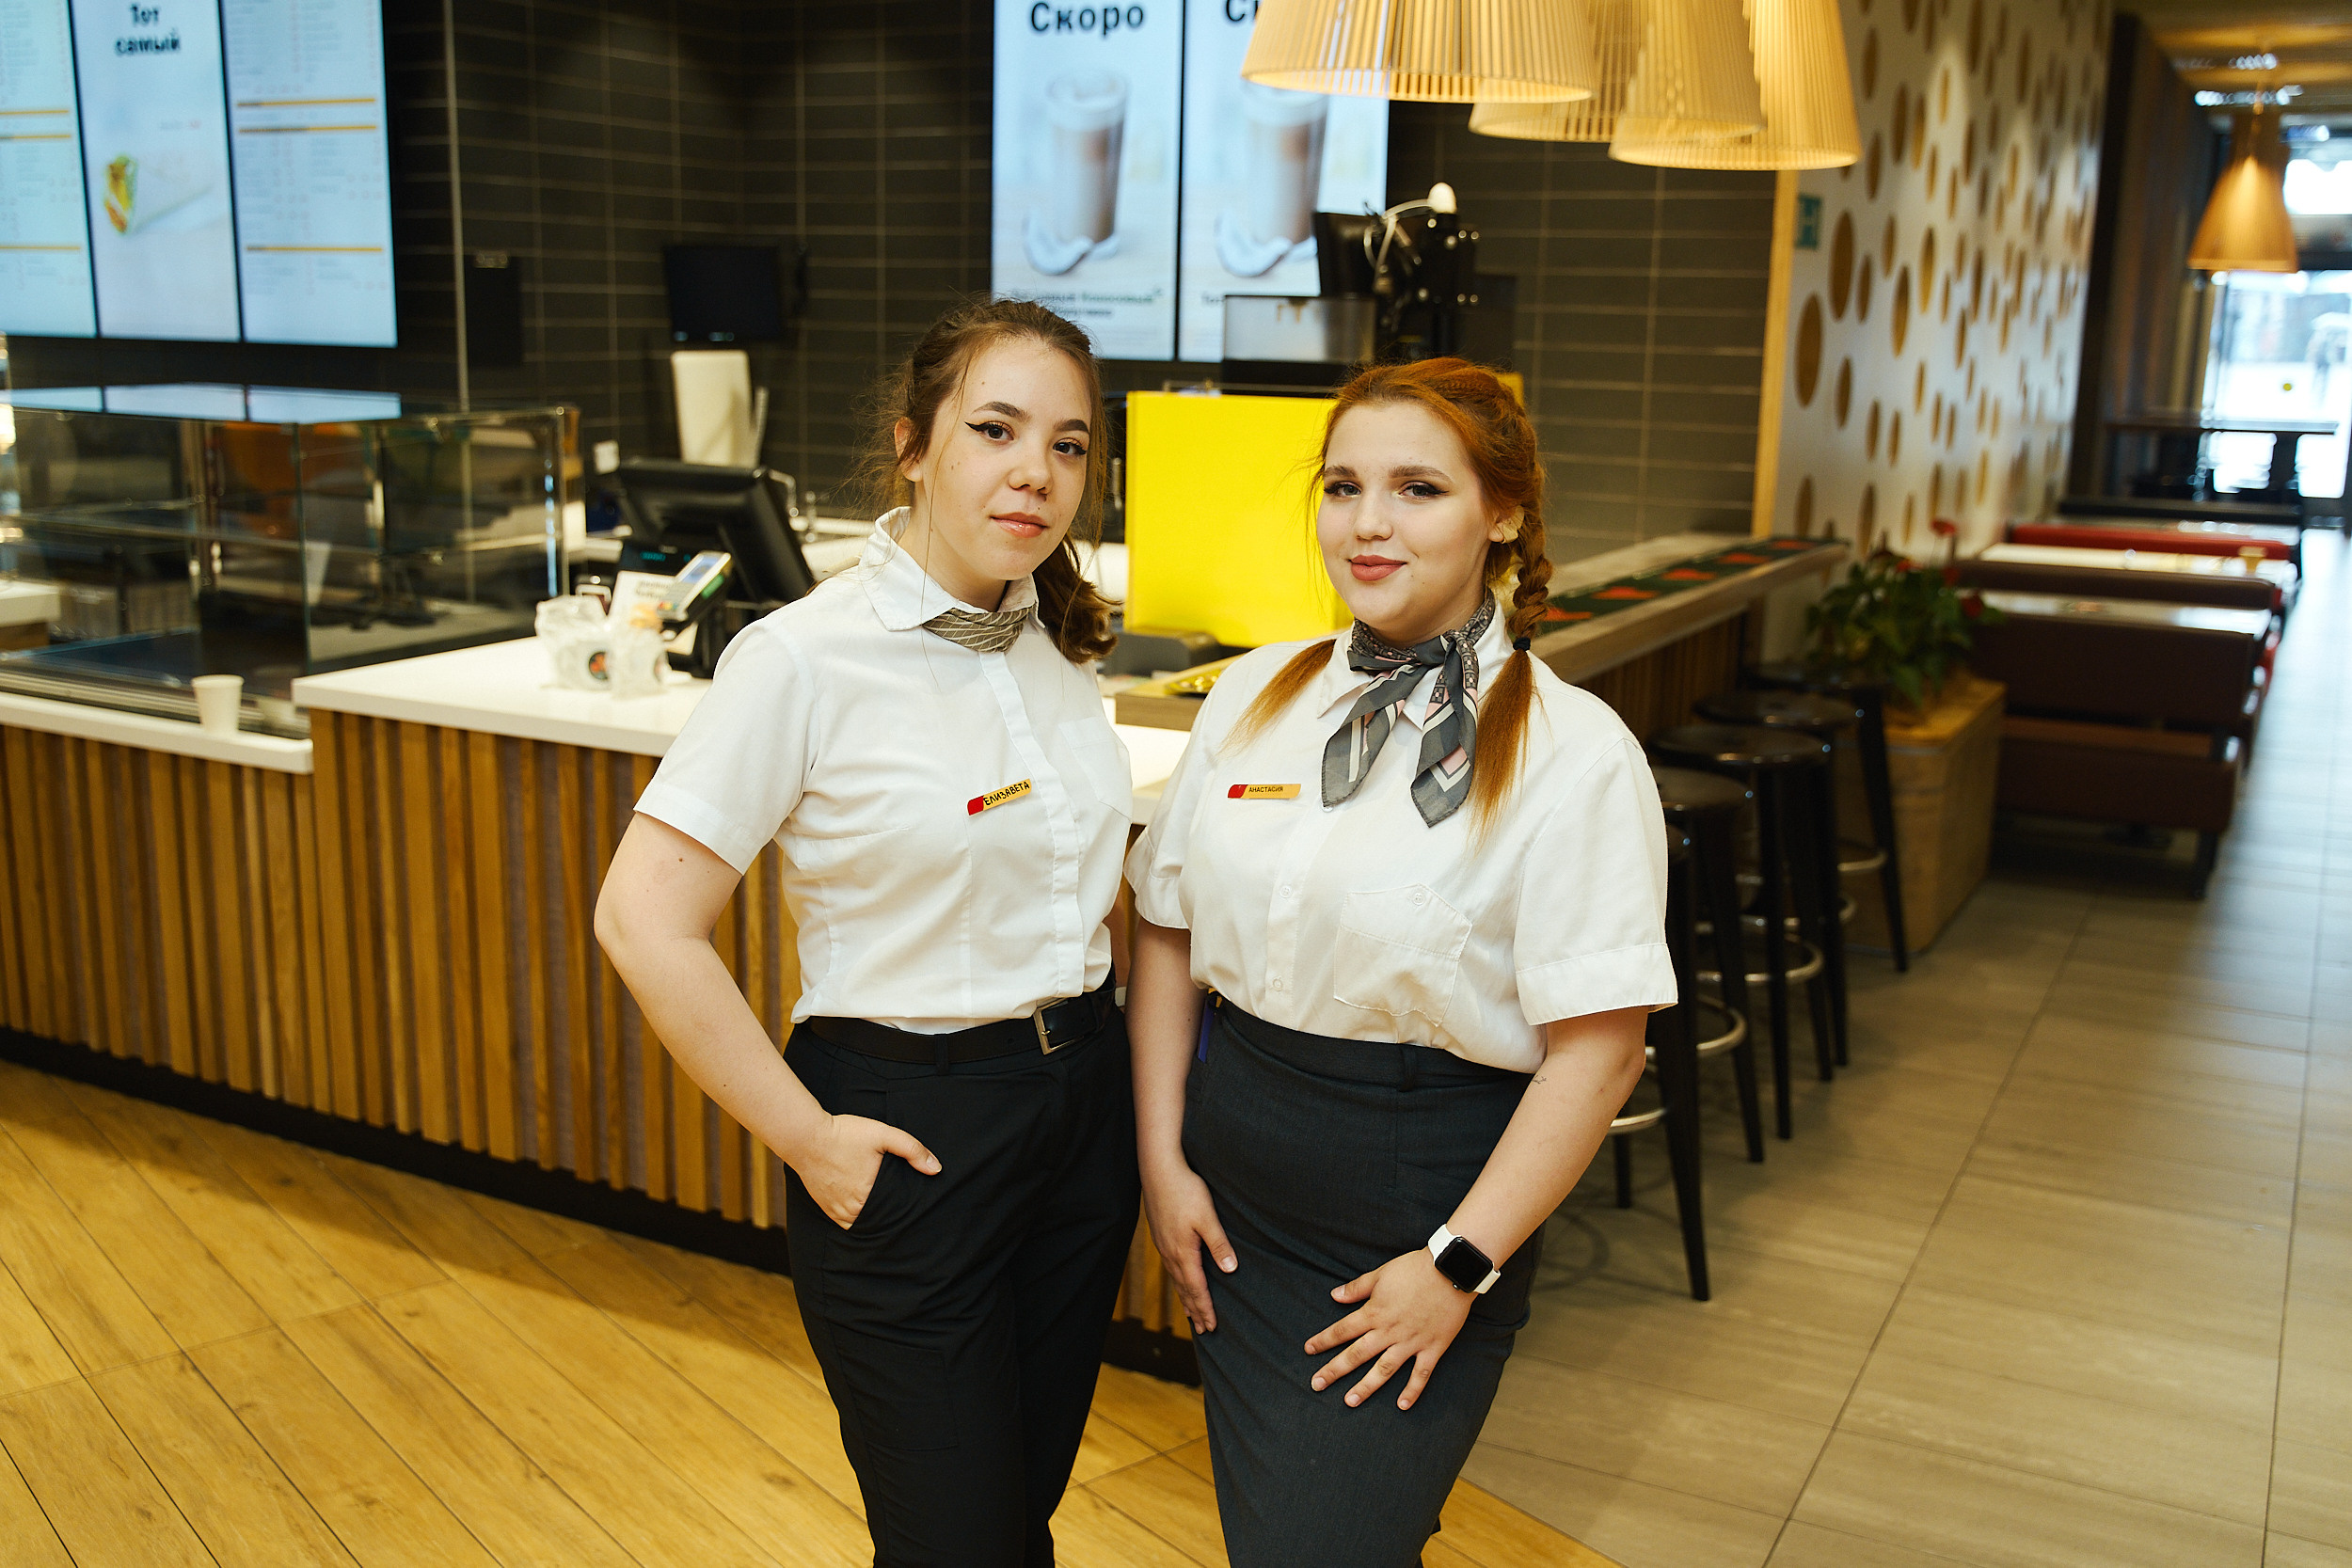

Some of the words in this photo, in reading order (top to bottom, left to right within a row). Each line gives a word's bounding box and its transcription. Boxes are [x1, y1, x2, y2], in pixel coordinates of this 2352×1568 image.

[131, 5, 160, 24] Тот
[1030, 2, 1144, 37] Скоро
[116, 28, 182, 55] самый
[982, 781, 1030, 806] ЕЛИЗАВЕТА
